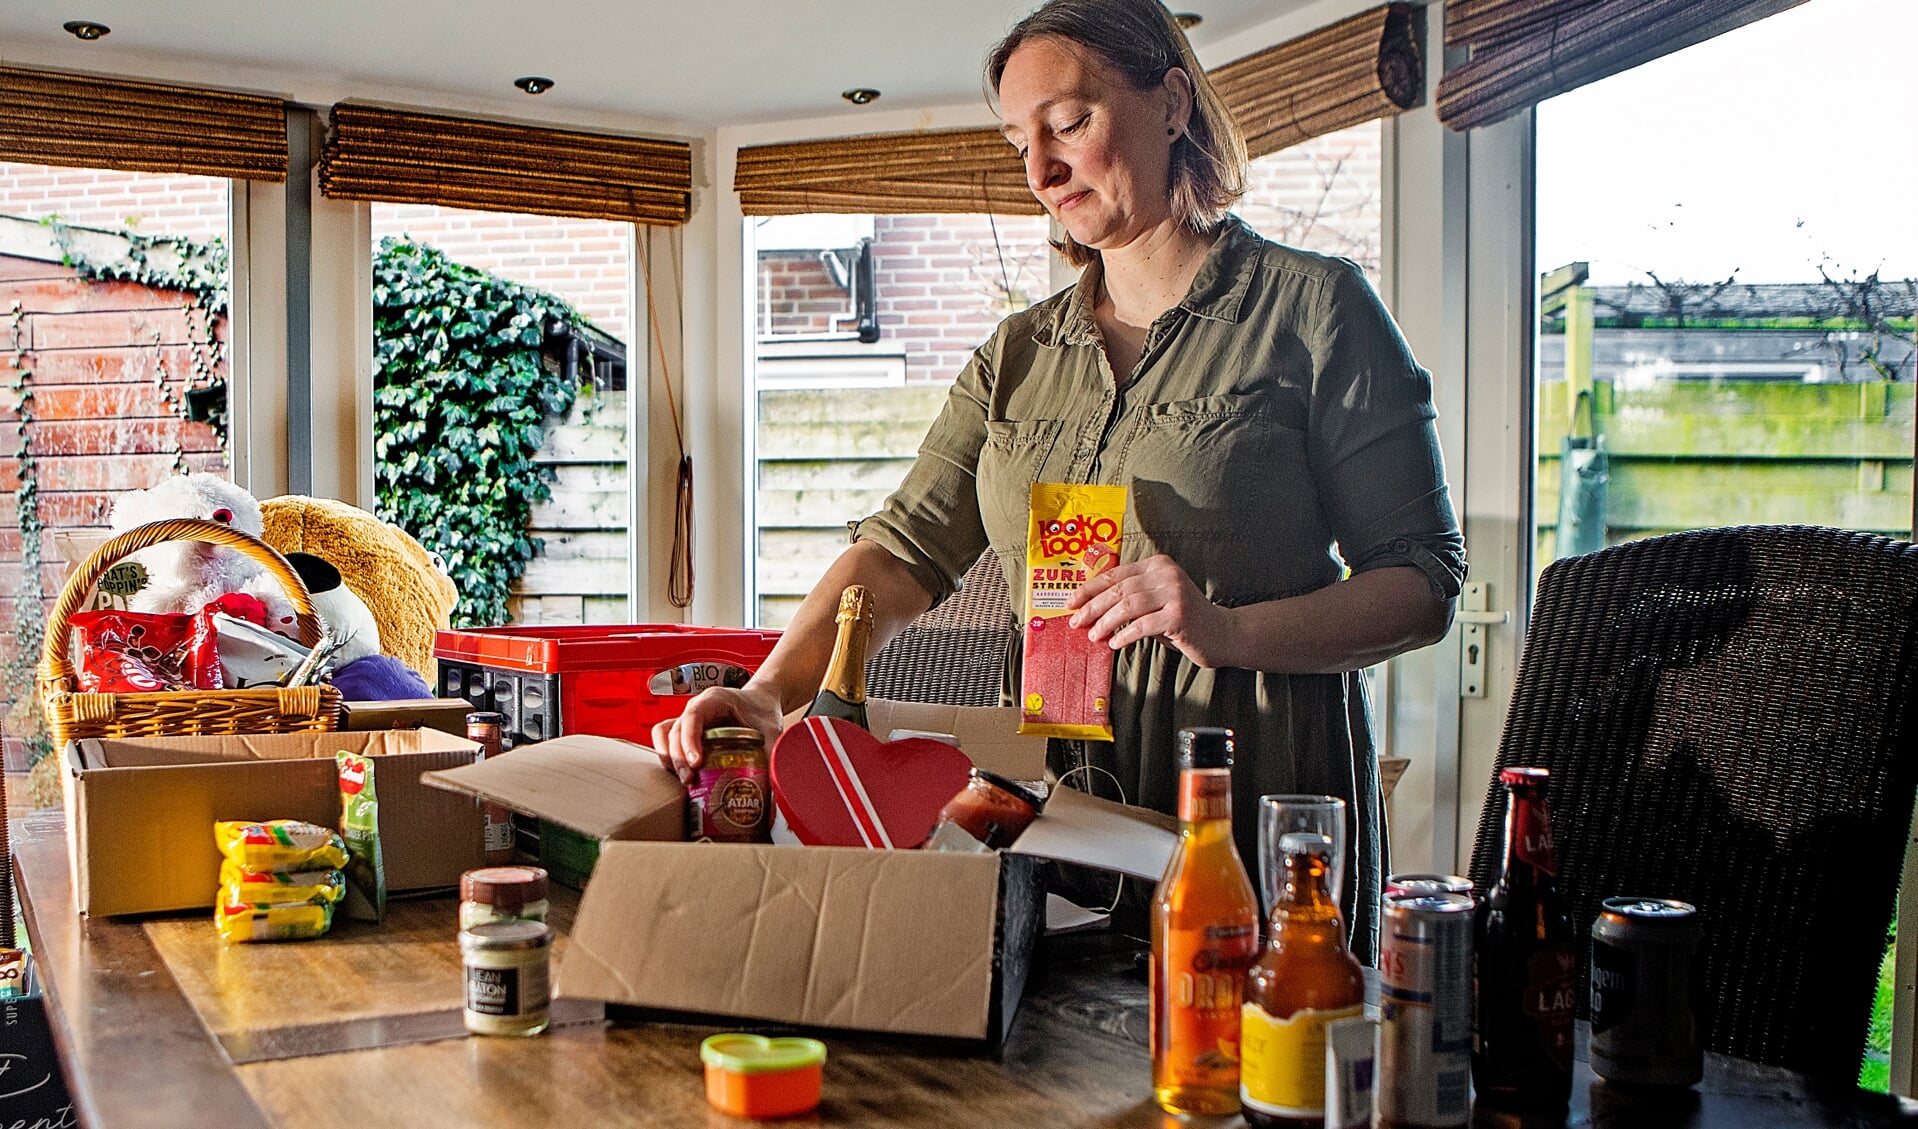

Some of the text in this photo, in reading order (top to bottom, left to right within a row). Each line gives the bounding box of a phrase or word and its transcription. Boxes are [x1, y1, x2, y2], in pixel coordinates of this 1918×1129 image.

[103, 565, 138, 582] HAT'S
[1033, 569, 1087, 582] ZURE
[1032, 582, 1083, 590] STREKE
[692, 665, 720, 681] BIO
[727, 797, 760, 808] ATJAR
